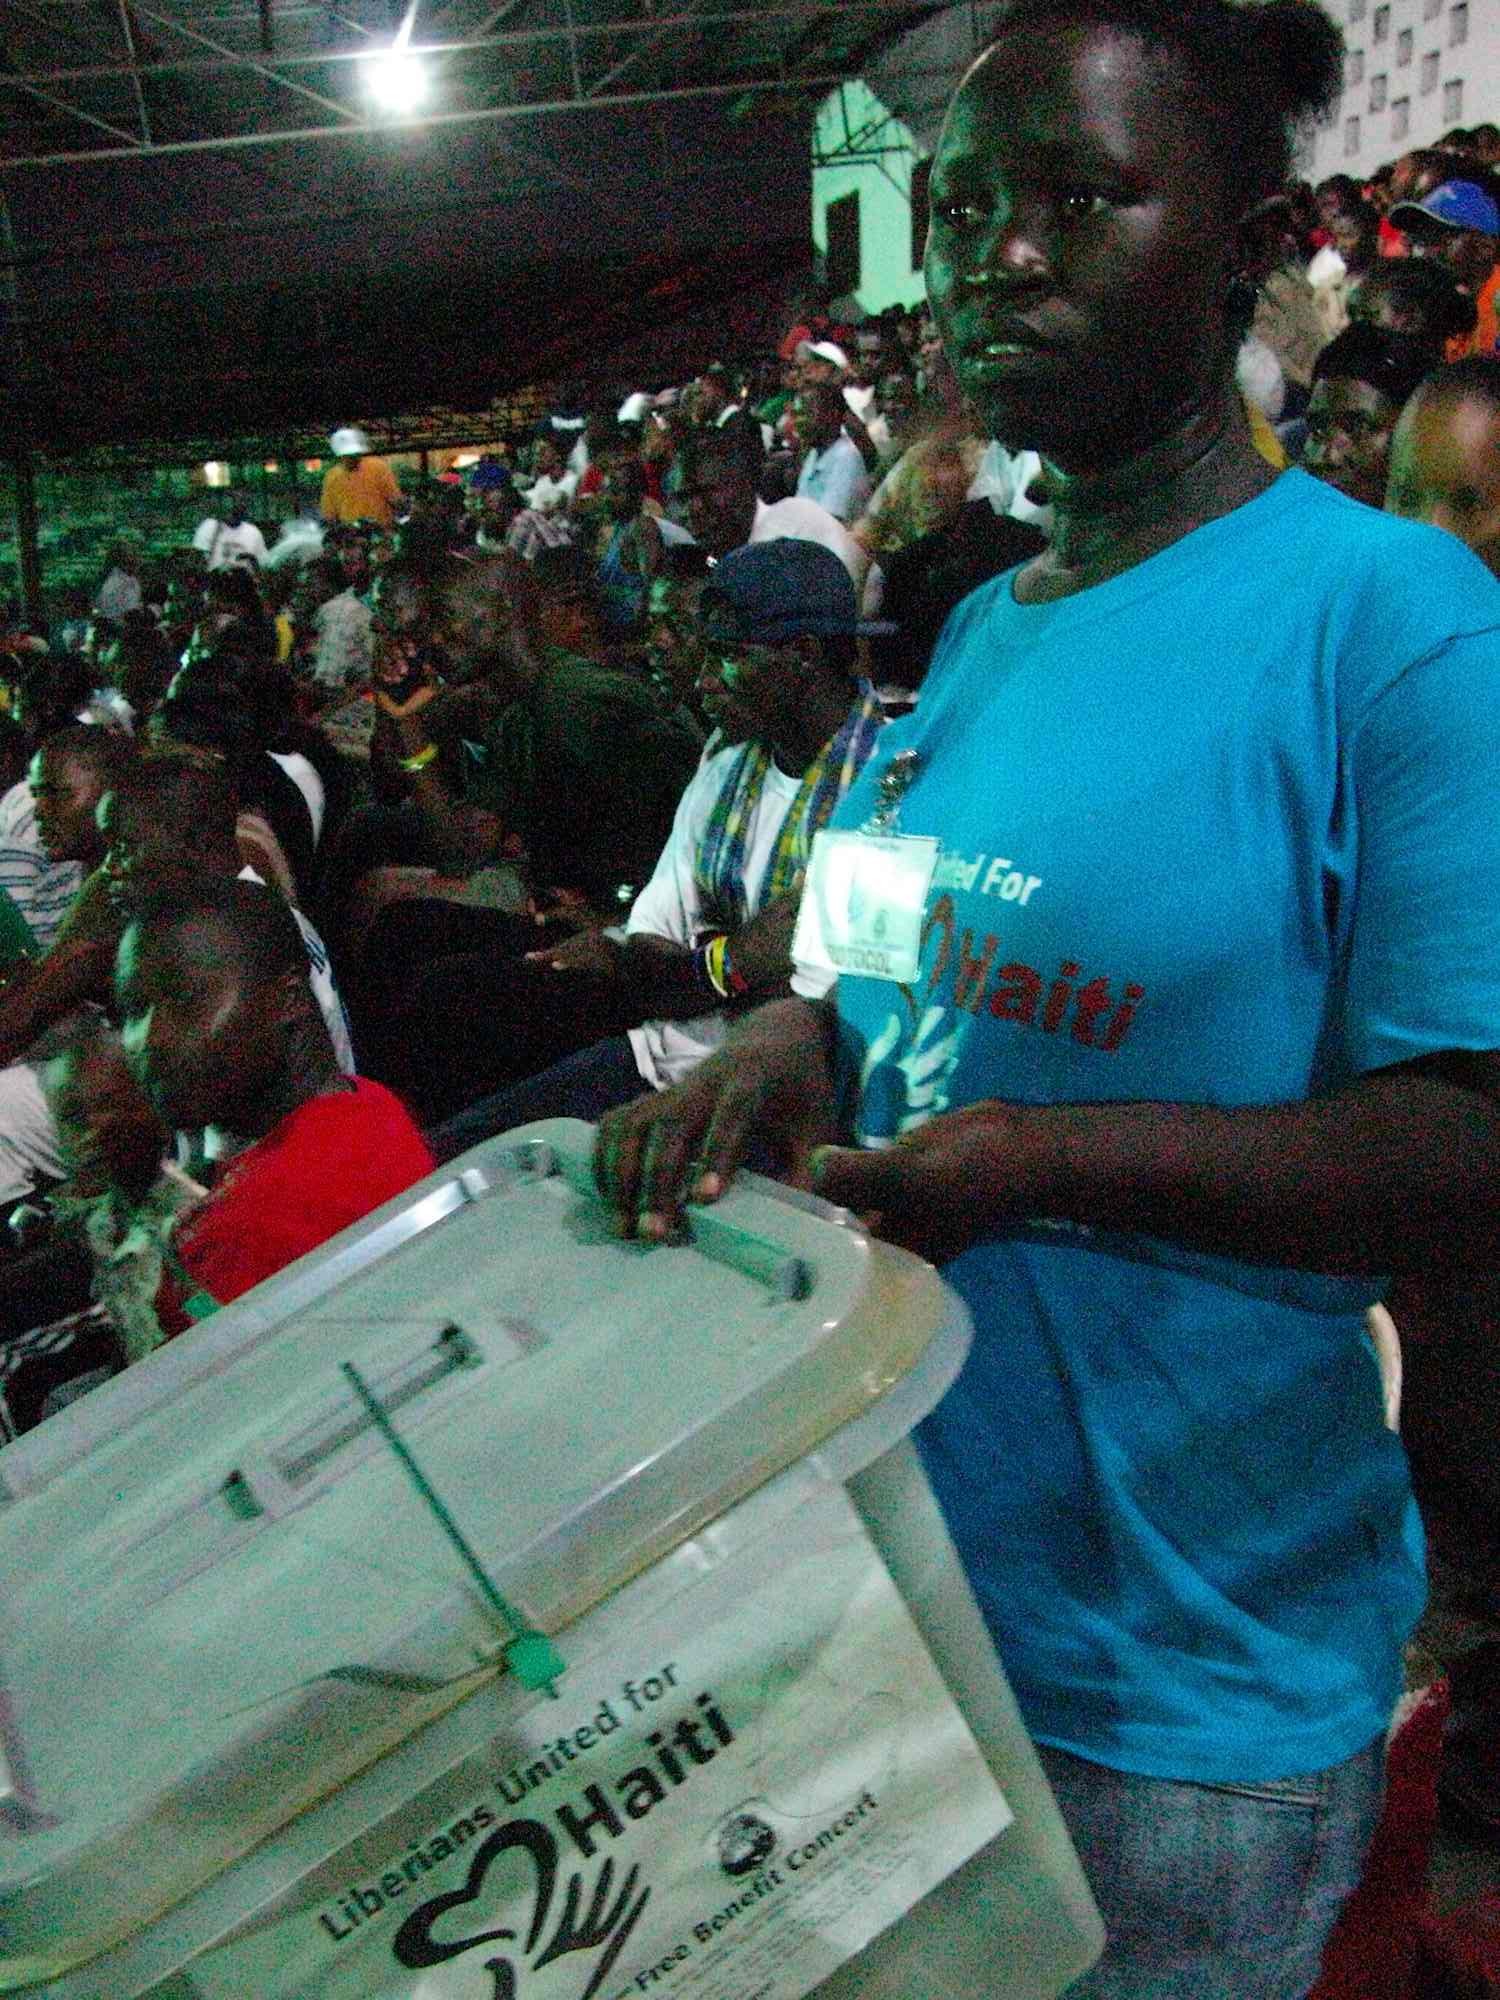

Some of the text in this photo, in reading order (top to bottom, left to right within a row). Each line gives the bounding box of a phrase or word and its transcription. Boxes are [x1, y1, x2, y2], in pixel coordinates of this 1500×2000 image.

[981, 857, 1042, 906] For
[954, 927, 1145, 1052] Haiti
[319, 1662, 678, 1941] Liberians United for
[555, 1691, 736, 1859] Haiti
[634, 1943, 690, 1991] Free
[692, 1869, 785, 1944] Benefit
[786, 1790, 878, 1871] Concert
